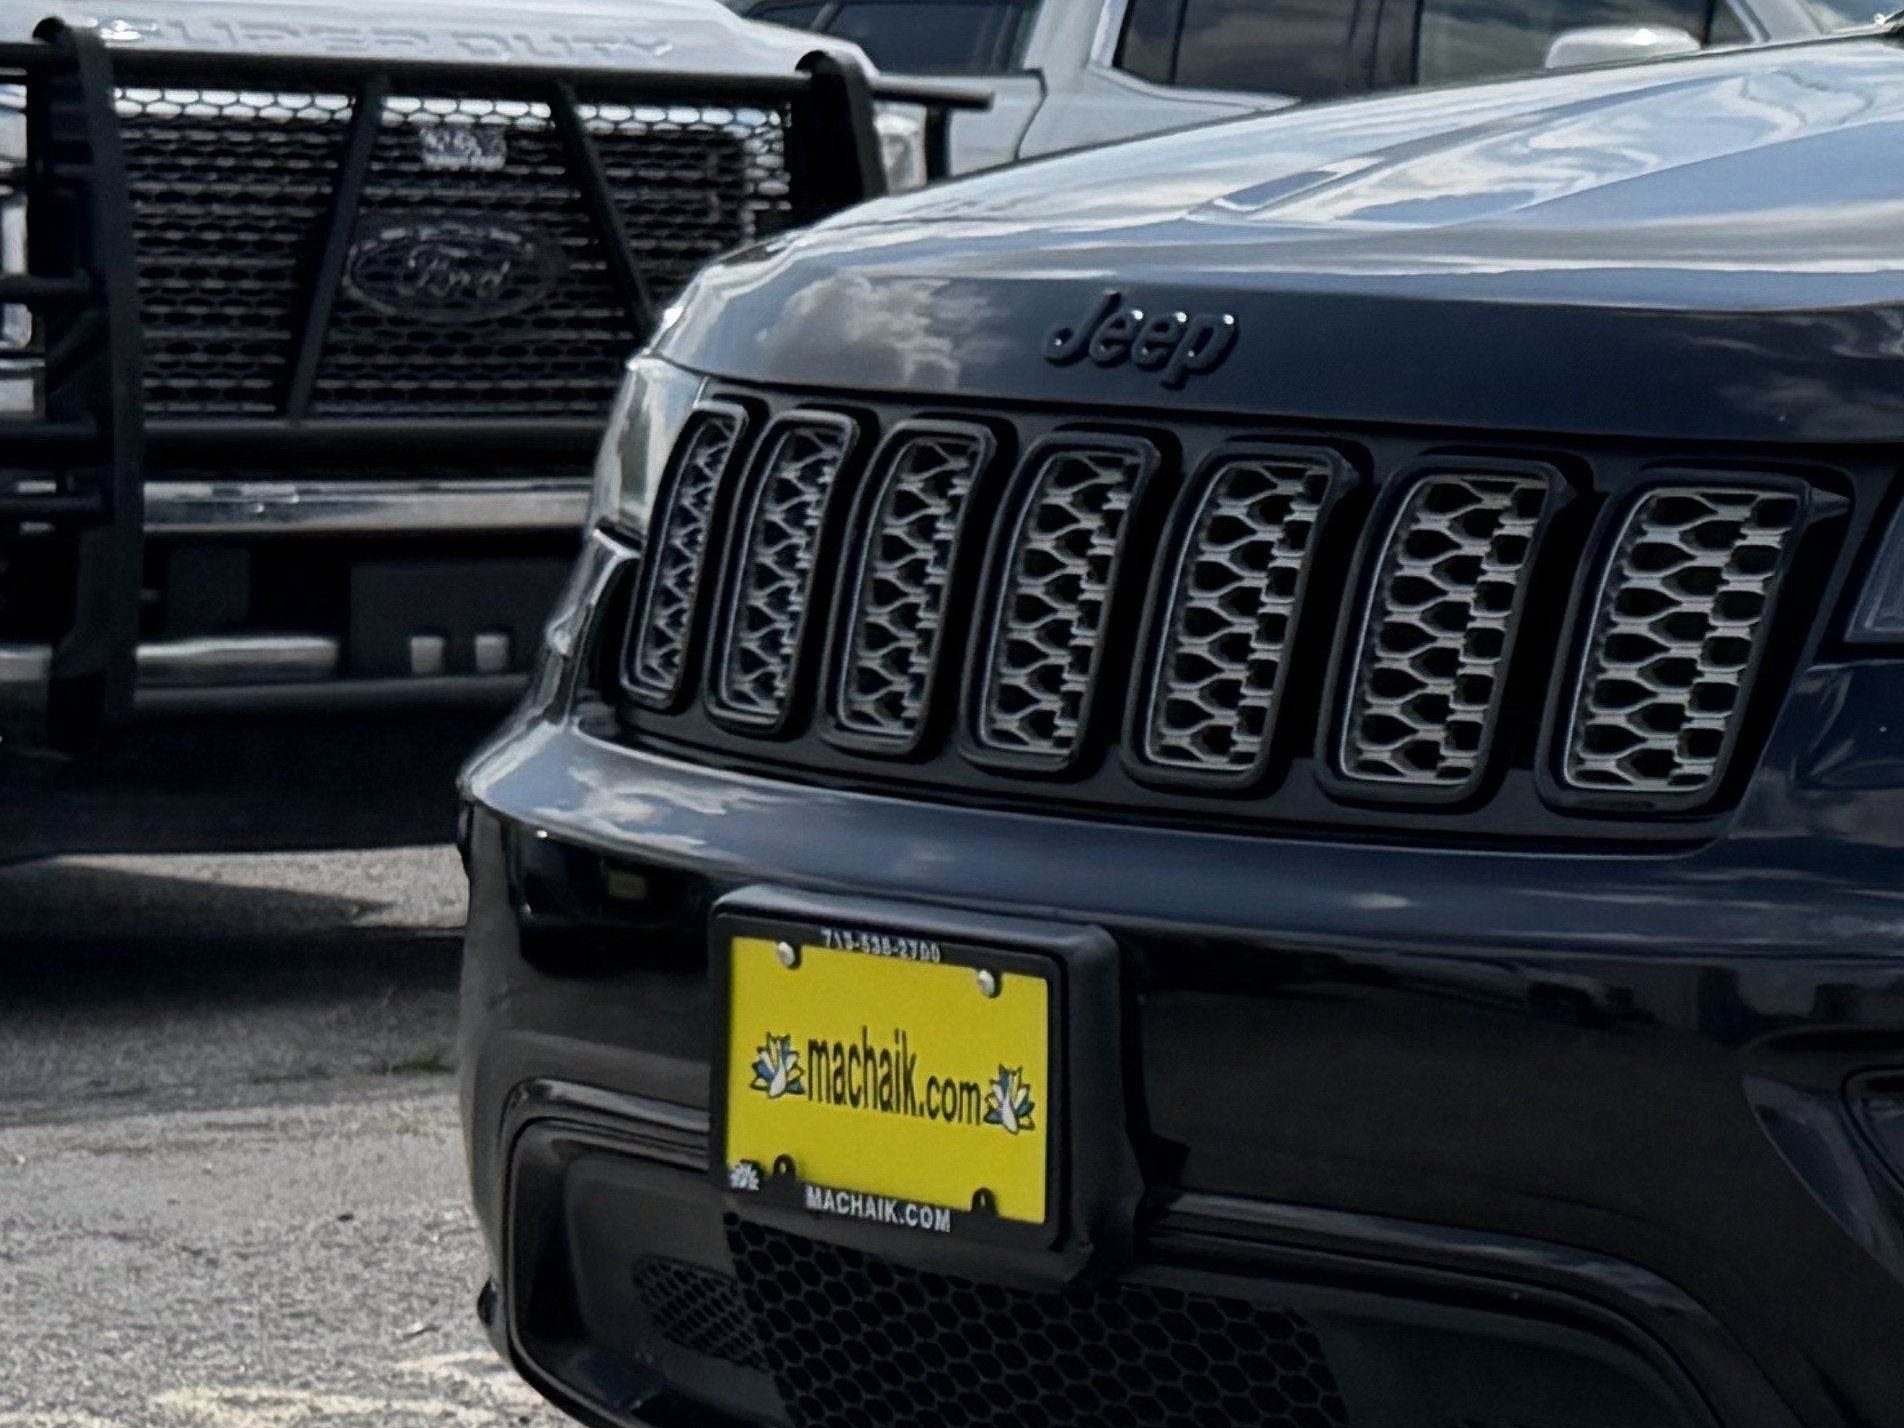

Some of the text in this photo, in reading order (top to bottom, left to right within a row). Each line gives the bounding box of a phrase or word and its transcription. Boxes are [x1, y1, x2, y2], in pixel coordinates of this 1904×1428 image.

[1044, 290, 1240, 391] Jeep
[807, 1026, 983, 1126] machaik.com
[805, 1186, 952, 1234] MACHAIK.COM
